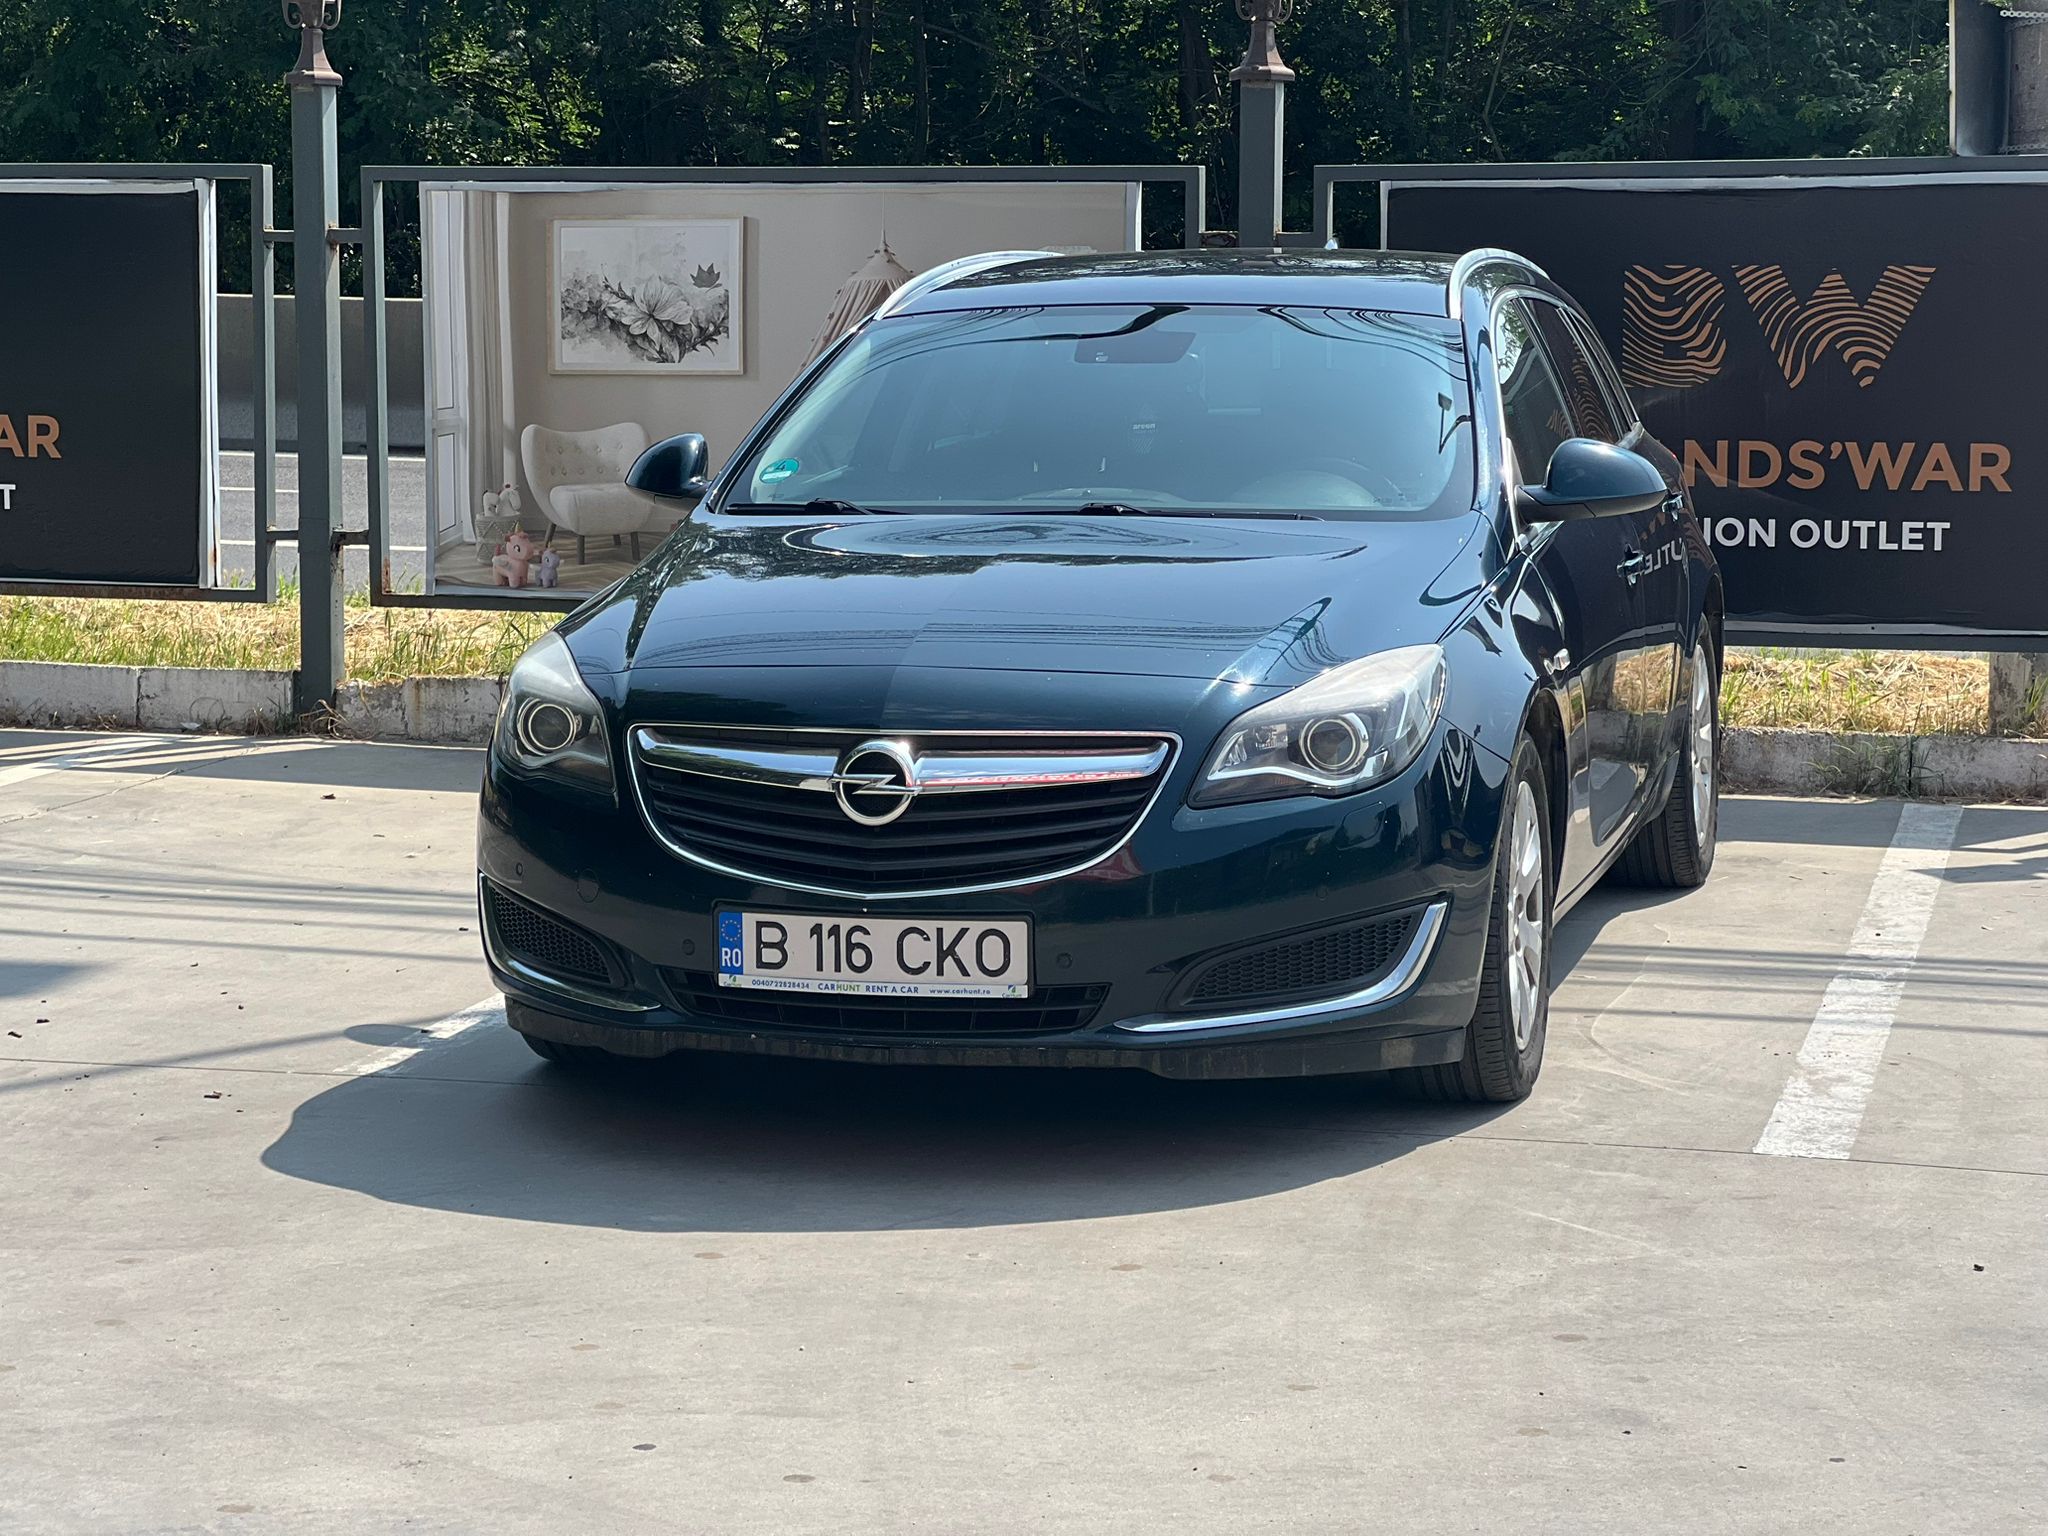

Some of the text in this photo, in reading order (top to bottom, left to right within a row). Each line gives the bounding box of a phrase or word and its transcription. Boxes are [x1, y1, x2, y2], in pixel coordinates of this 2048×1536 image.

[1683, 439, 2012, 493] NDS'WAR
[1700, 517, 1951, 551] ION OUTLET
[721, 947, 742, 967] RO
[755, 920, 1011, 978] B 116 CKO
[817, 982, 861, 992] CARHUNT
[865, 984, 888, 993] RENT
[900, 986, 919, 994] CAR
